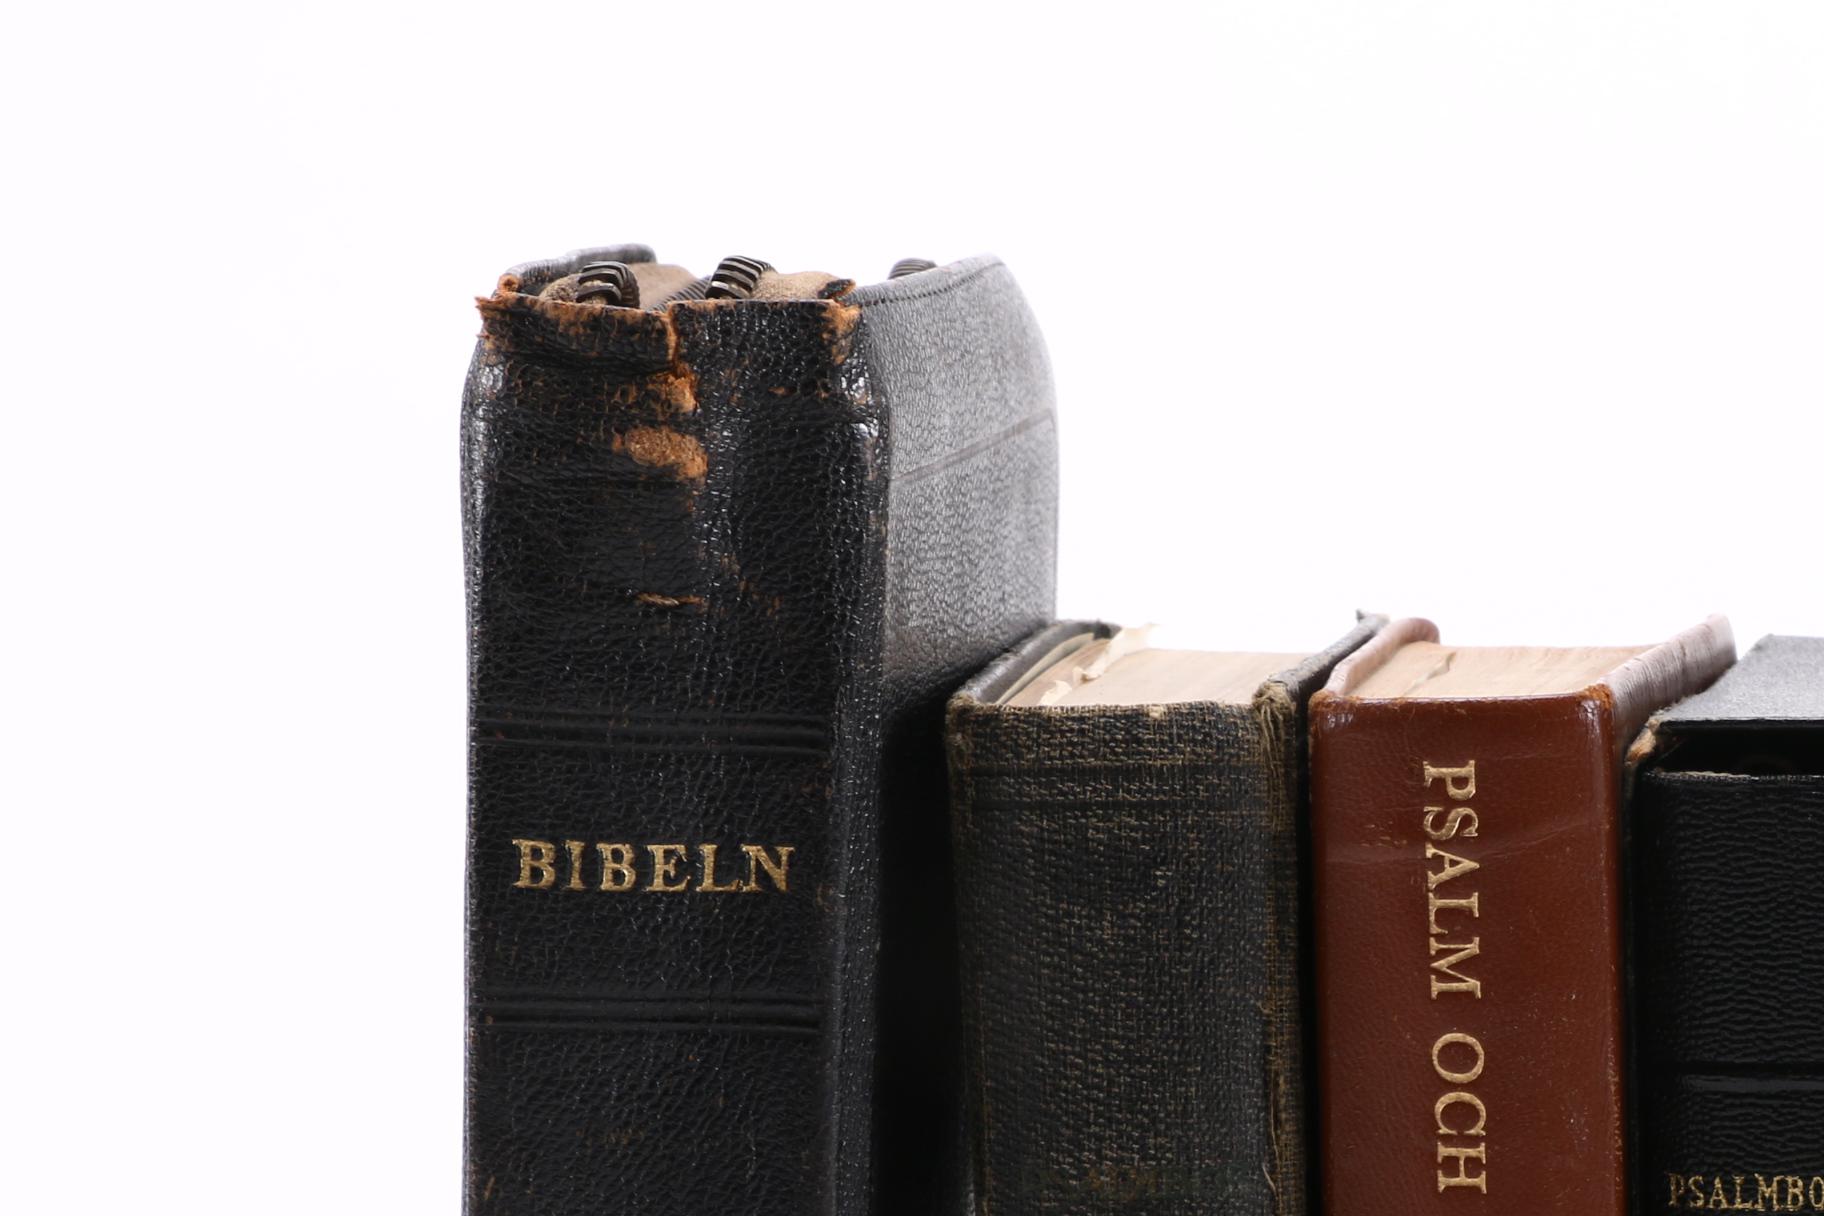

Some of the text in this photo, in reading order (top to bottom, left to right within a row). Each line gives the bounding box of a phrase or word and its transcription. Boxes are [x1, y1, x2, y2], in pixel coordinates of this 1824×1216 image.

[510, 837, 796, 893] BIBELN
[1422, 759, 1482, 999] PSALM
[1431, 1032, 1488, 1194] OCH
